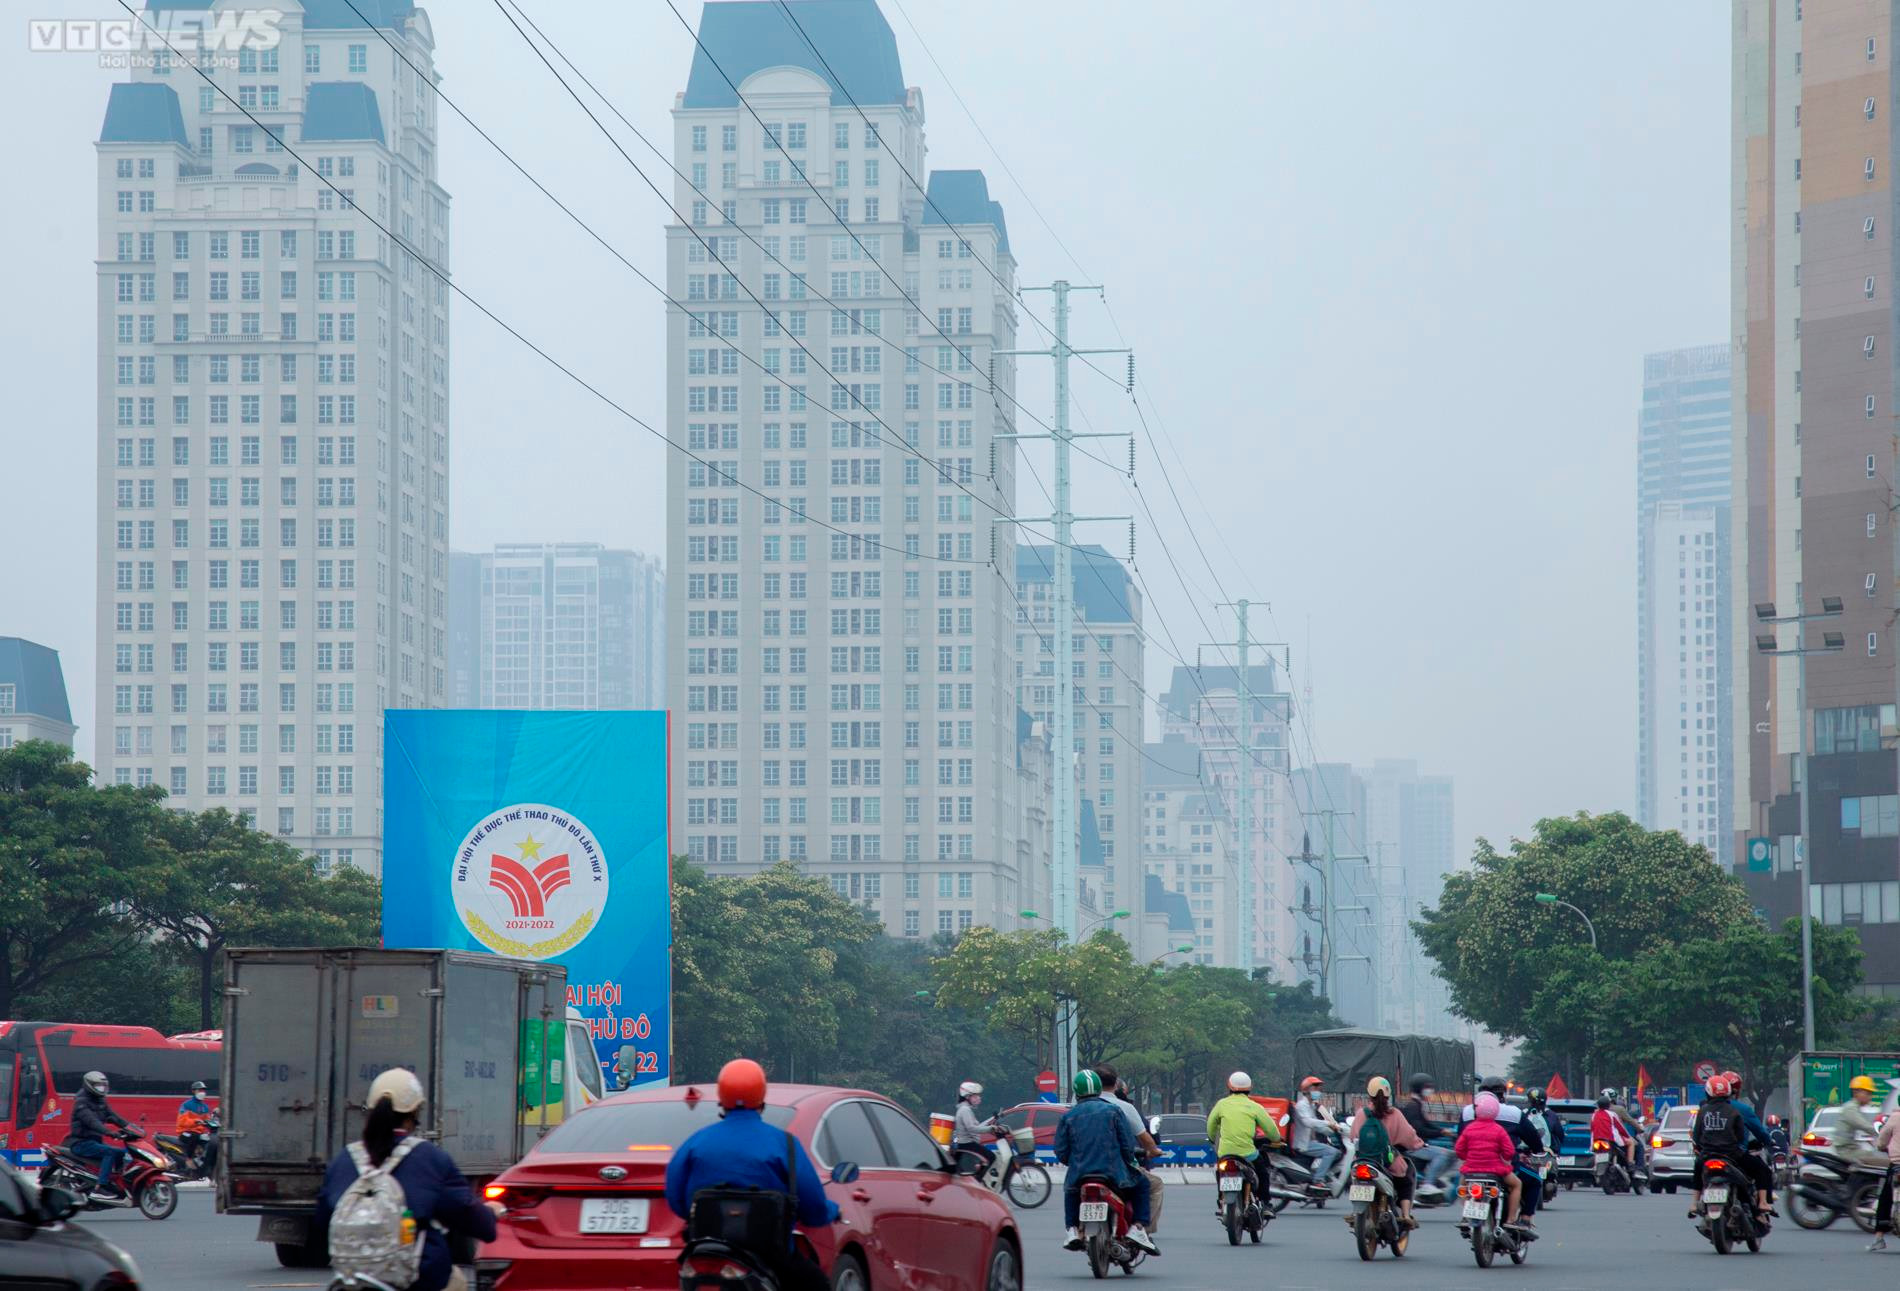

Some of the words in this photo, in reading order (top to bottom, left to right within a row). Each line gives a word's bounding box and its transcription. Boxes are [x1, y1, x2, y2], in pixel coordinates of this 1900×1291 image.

[524, 811, 548, 820] THAO
[551, 814, 569, 828] THỦ
[484, 818, 503, 833] DỤC
[461, 847, 474, 863] HỘI
[458, 865, 469, 882] ĐẠI
[587, 980, 621, 1011] HỘI
[586, 1012, 617, 1039] HỦ
[621, 1013, 651, 1039] ĐÔ
[612, 1051, 659, 1073] 222
